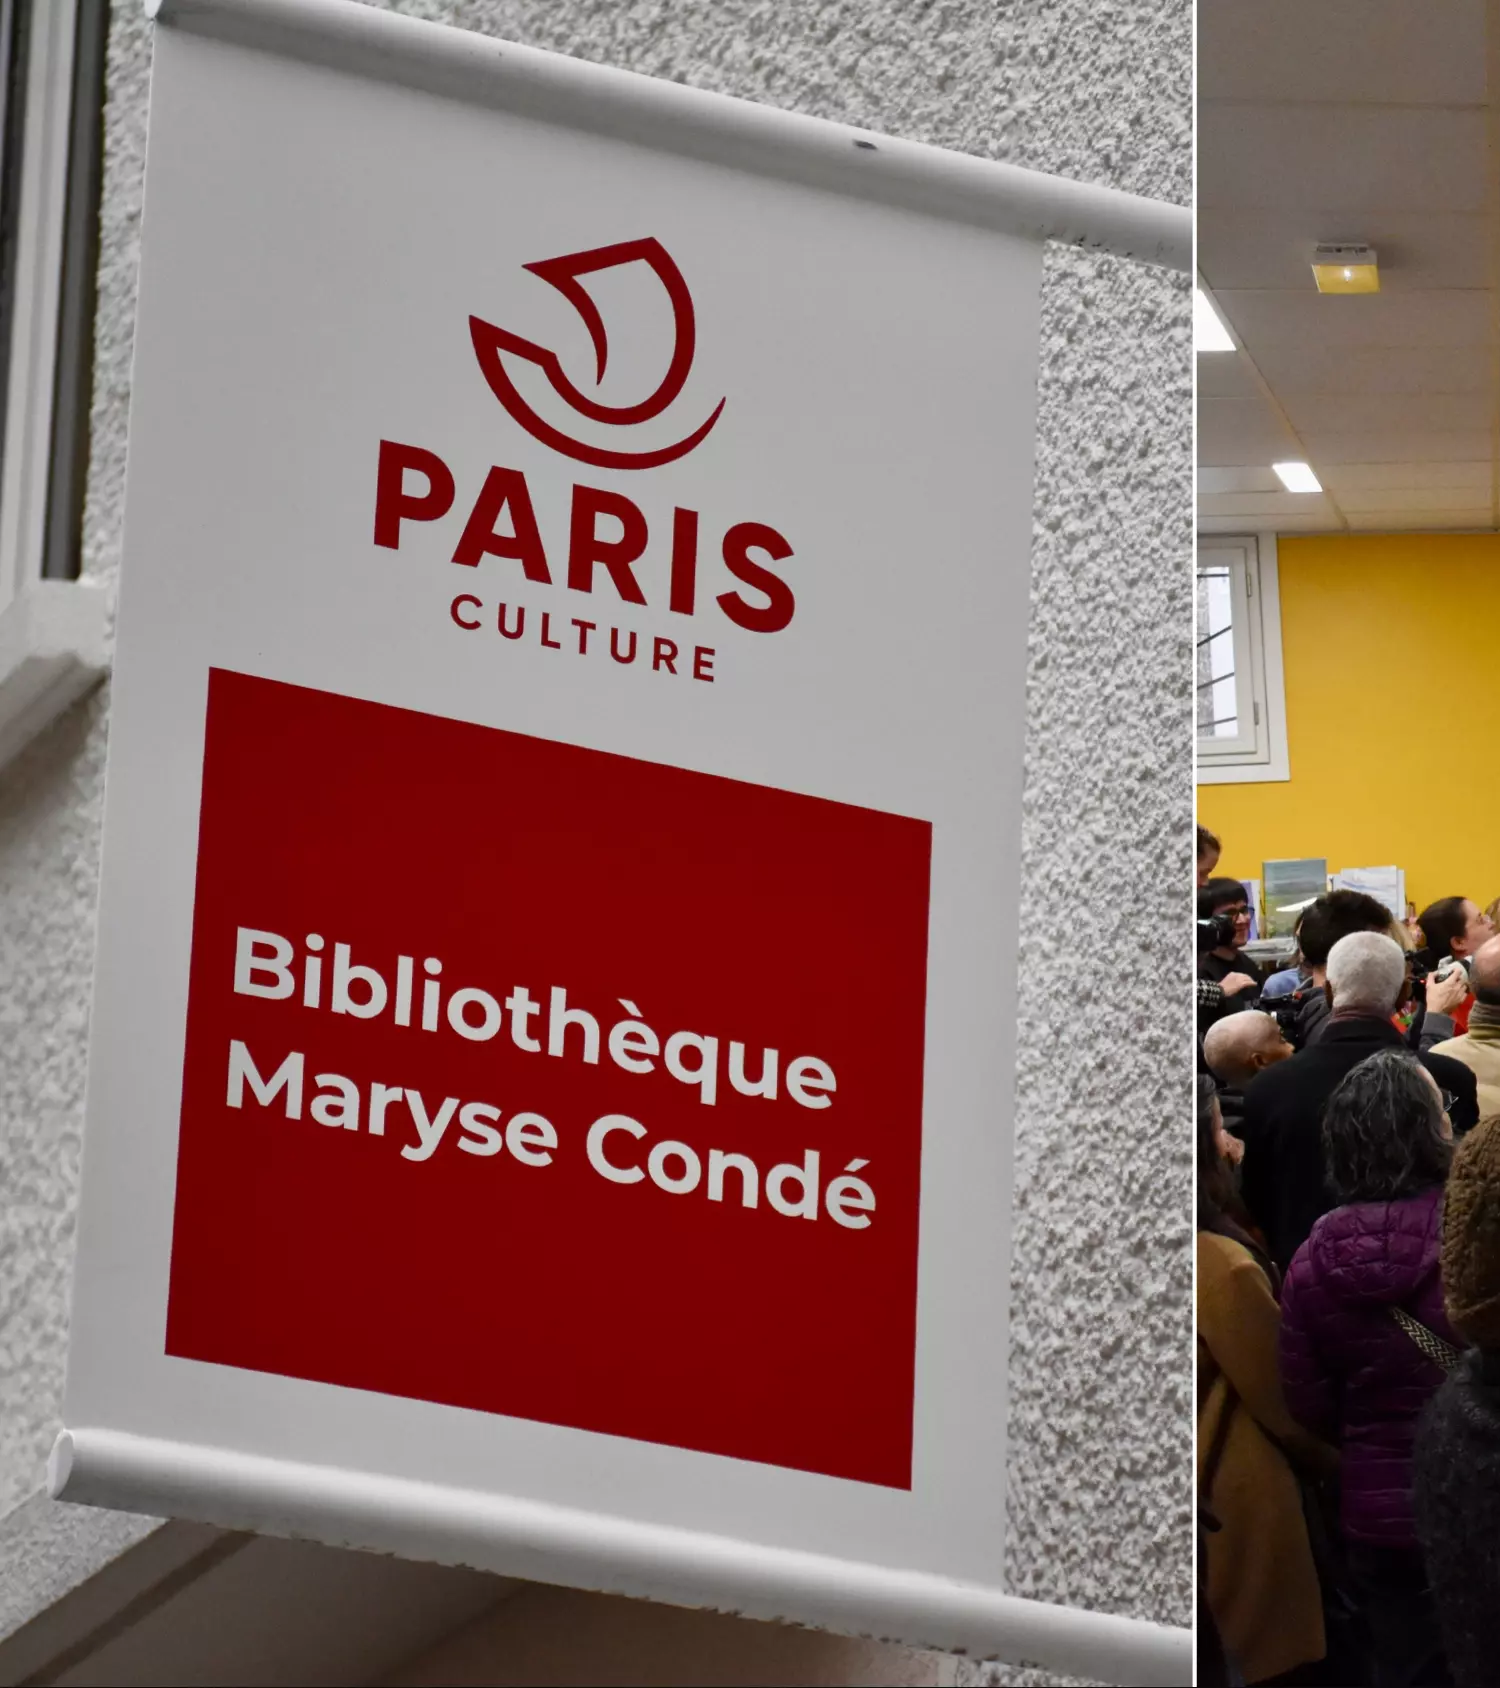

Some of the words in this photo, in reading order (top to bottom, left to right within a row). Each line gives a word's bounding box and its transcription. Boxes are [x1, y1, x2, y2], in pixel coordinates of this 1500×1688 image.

[374, 439, 795, 633] PARIS
[450, 594, 716, 682] CULTURE
[233, 926, 837, 1110] Bibliothèque
[226, 1039, 558, 1167] Maryse
[586, 1114, 876, 1230] Condé
